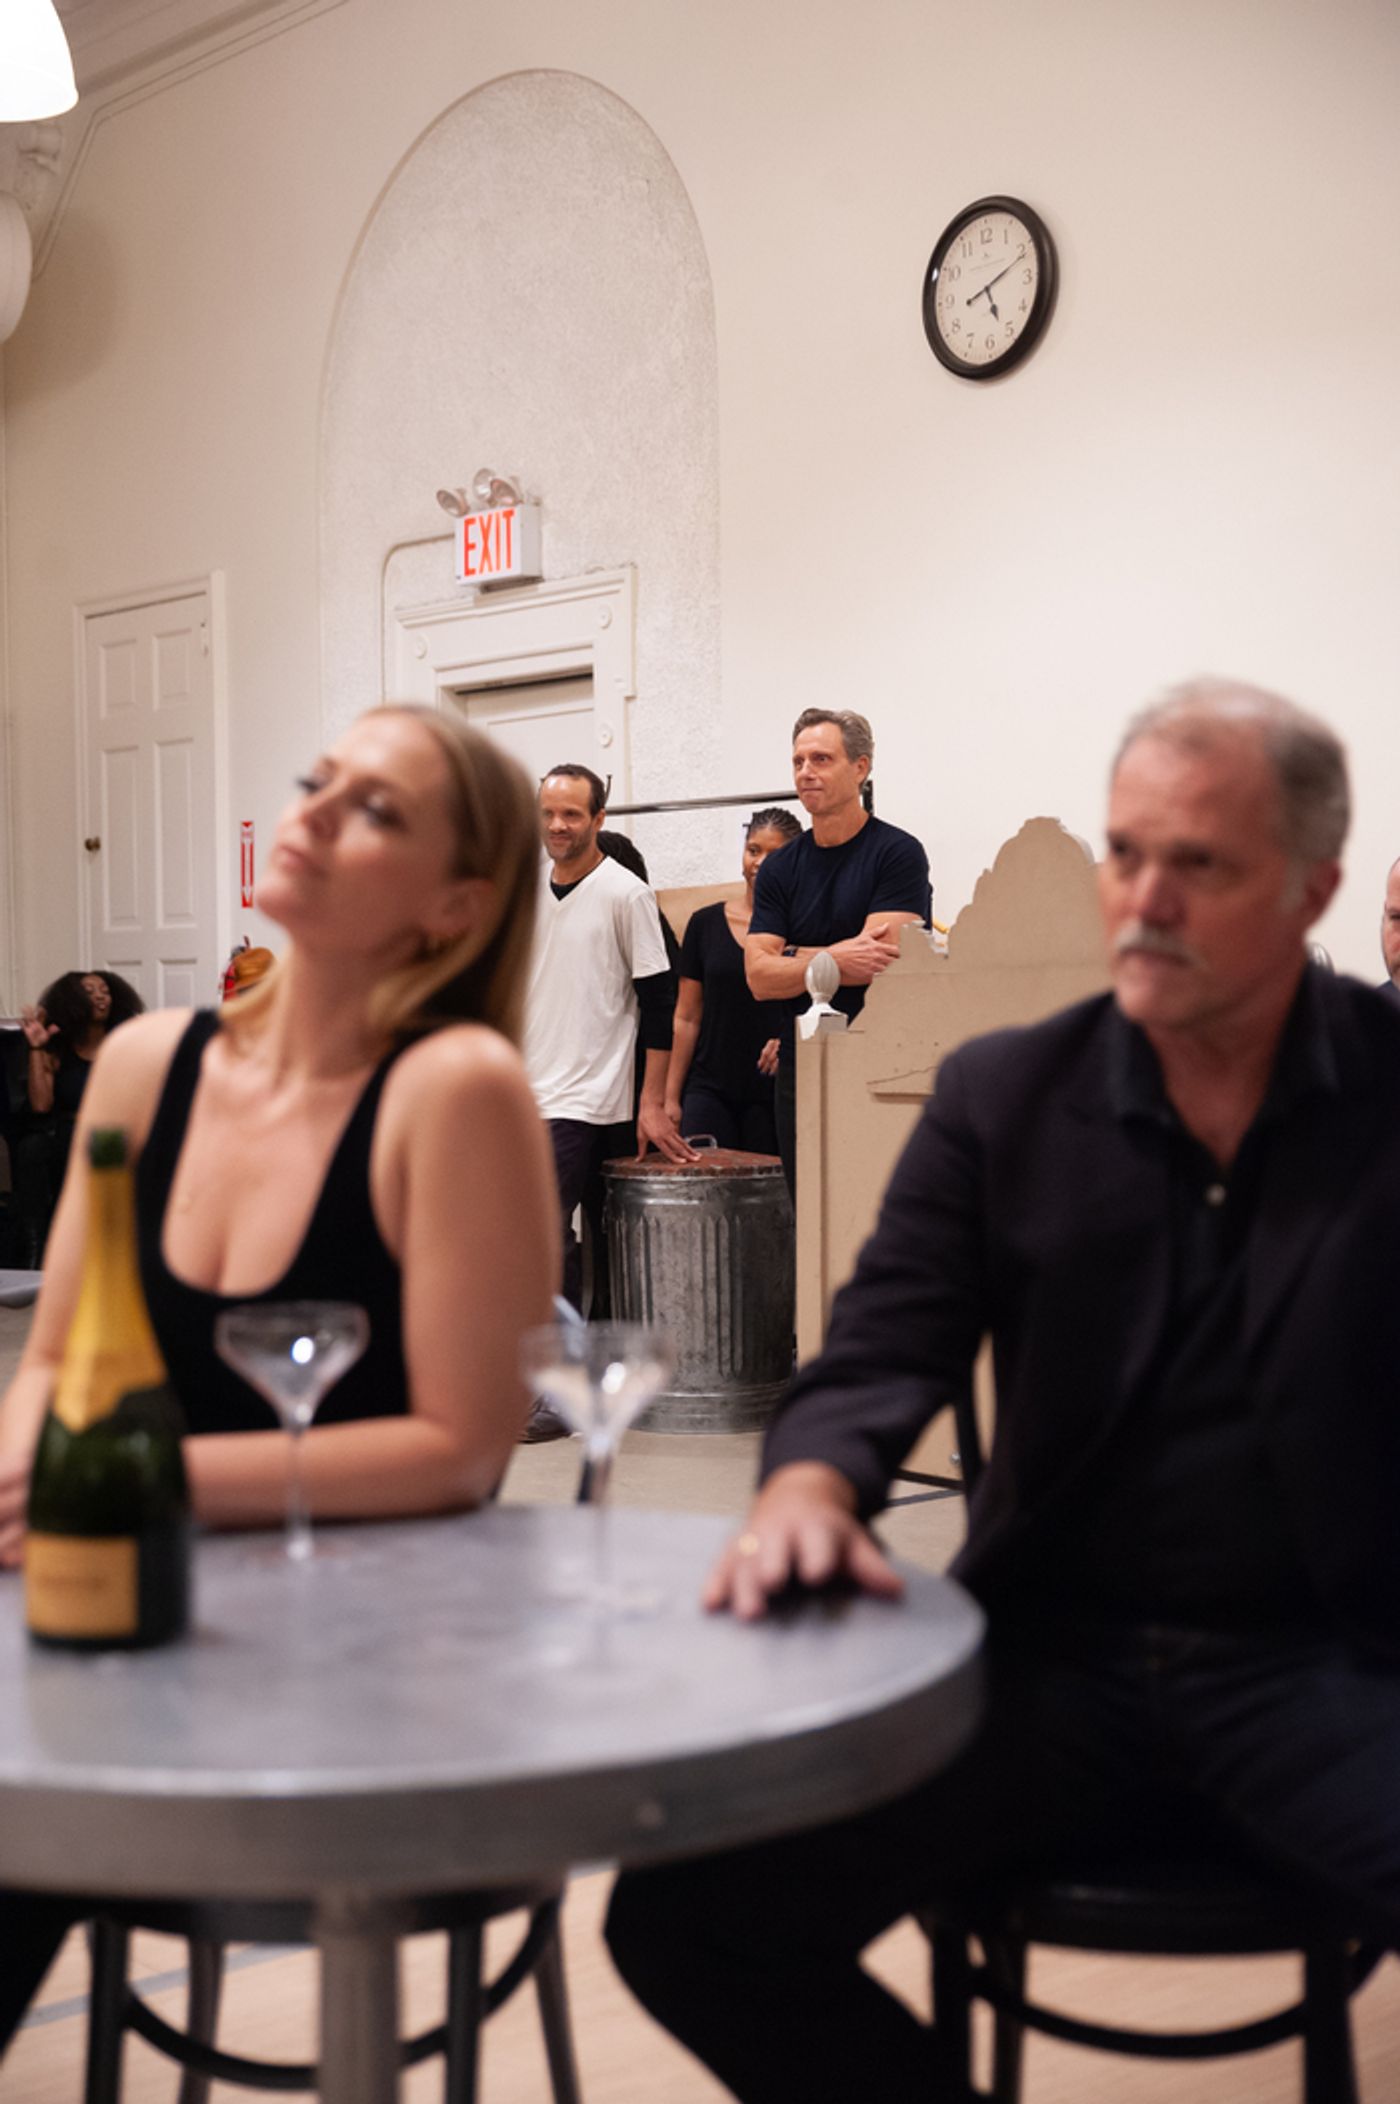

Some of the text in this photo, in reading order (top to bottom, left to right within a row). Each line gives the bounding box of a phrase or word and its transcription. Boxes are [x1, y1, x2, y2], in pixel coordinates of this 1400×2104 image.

[981, 228, 992, 244] 12
[962, 241, 973, 258] 11
[1016, 243, 1026, 260] 2
[948, 265, 960, 281] 10
[1023, 268, 1032, 285] 3
[946, 294, 955, 309] 9
[1018, 298, 1028, 312] 4
[951, 319, 961, 334] 8
[1004, 321, 1015, 338] 5
[966, 332, 975, 349] 7
[985, 334, 995, 349] 6
[464, 508, 515, 577] EXIT
